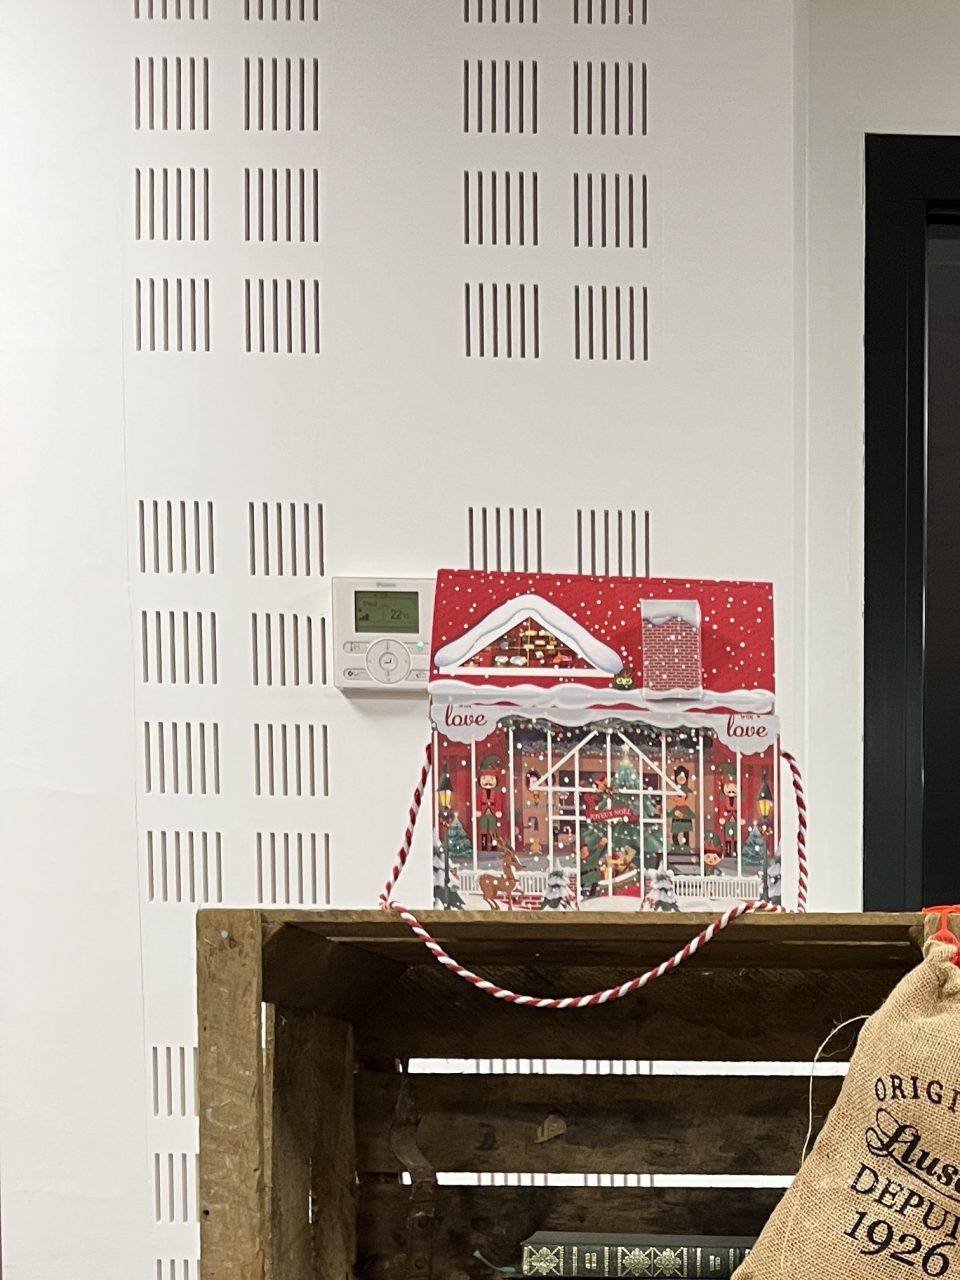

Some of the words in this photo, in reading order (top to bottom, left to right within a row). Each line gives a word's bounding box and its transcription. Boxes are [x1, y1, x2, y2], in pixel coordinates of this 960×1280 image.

[445, 704, 487, 727] love
[727, 714, 768, 737] love
[843, 1210, 956, 1278] 1926
